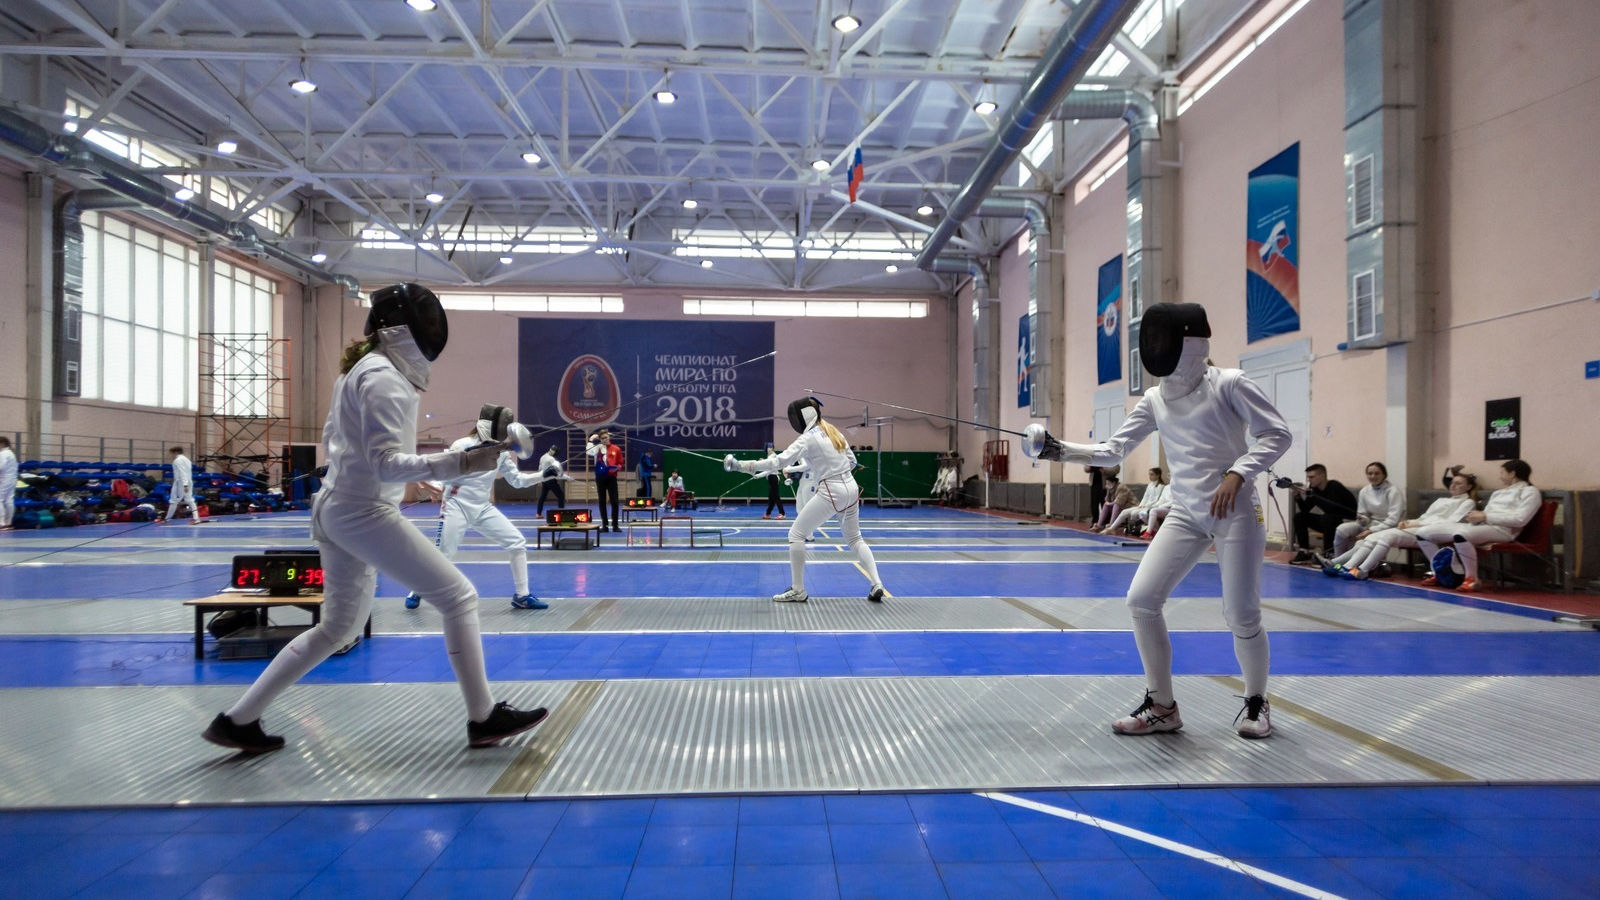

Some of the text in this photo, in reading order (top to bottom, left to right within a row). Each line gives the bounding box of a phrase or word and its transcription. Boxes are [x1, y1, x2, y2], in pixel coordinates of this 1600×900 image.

[654, 354, 737, 366] ЧЕМПИОНАТ
[655, 367, 737, 381] МИРА ПО
[654, 383, 737, 394] ФУТБОЛУ FIFA
[655, 395, 736, 423] 2018
[654, 424, 737, 437] В РОССИИ
[237, 568, 324, 586] 27 9 39
